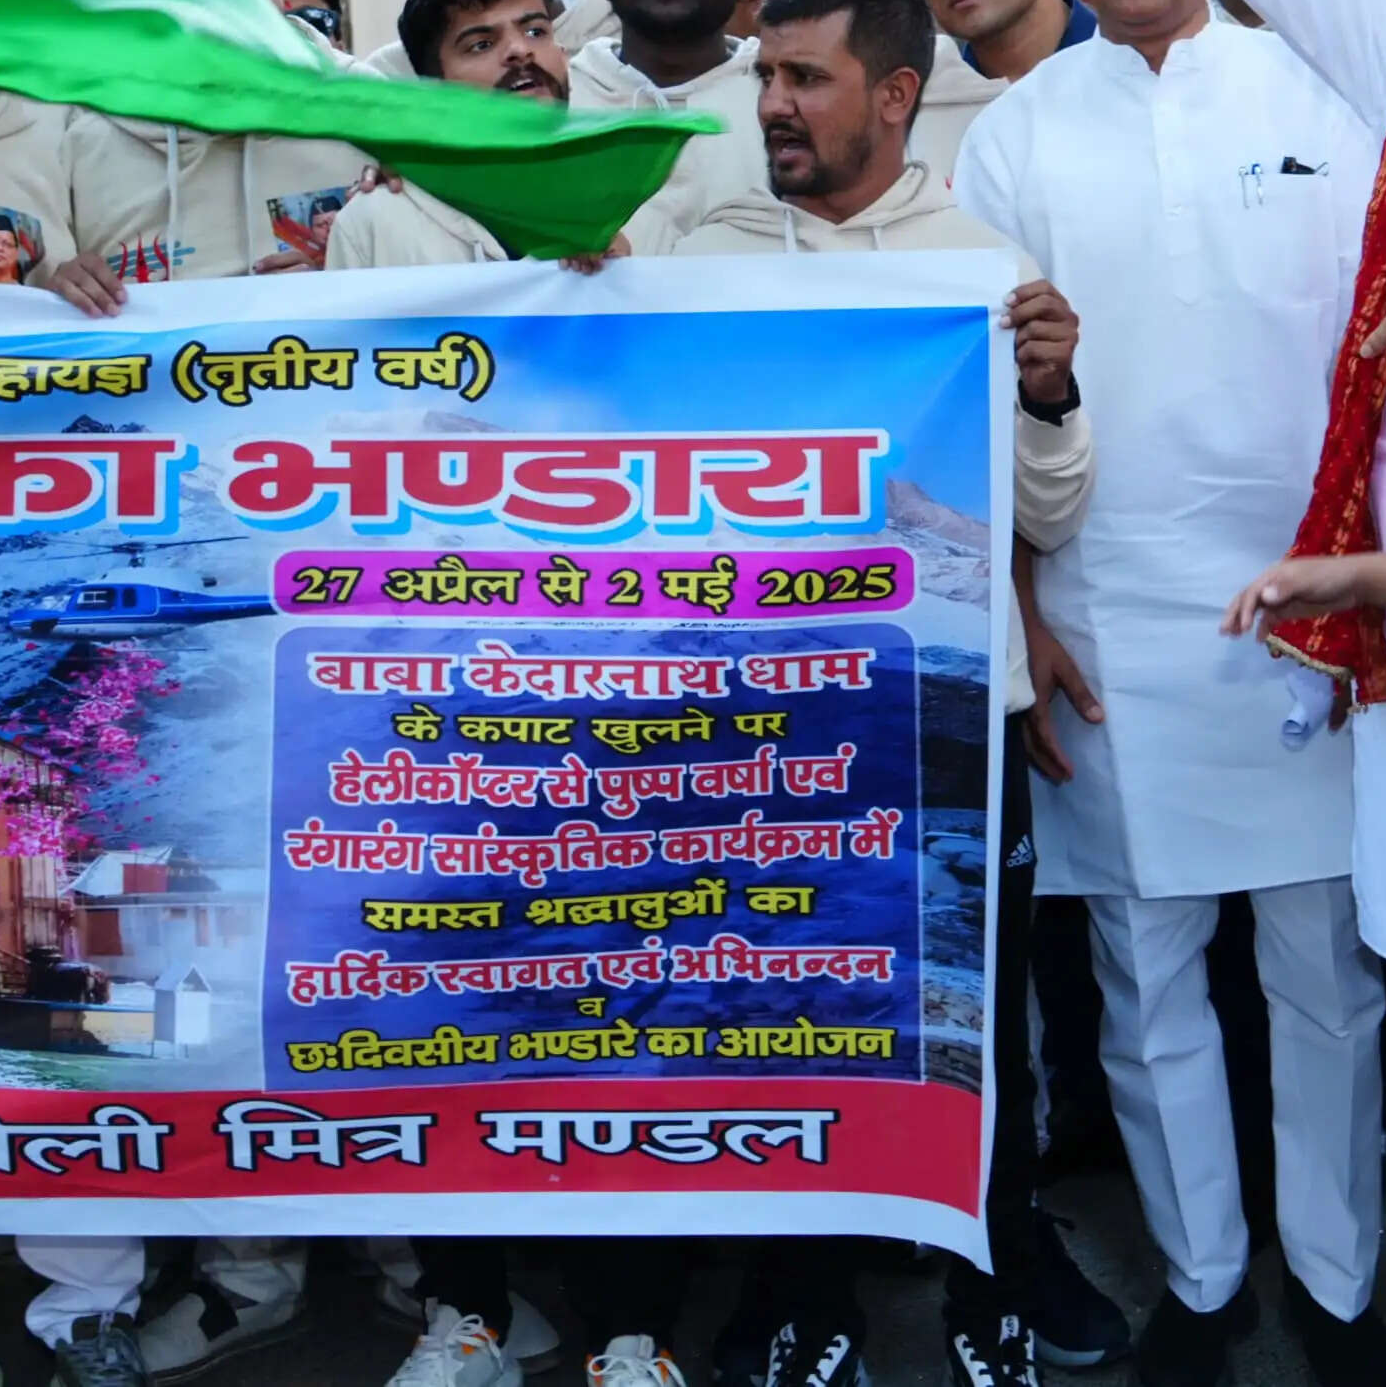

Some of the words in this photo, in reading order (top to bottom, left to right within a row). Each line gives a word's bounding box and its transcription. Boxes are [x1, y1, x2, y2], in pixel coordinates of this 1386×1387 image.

[172, 336, 356, 405] (तृतीय
[374, 331, 495, 401] वर्ष)
[222, 434, 883, 529] भण्डारा
[293, 567, 360, 603] 27
[384, 556, 520, 606] अप्रैल
[538, 557, 587, 605] से
[608, 568, 643, 605] 2
[662, 558, 735, 613] मई
[757, 566, 895, 606] 2025
[313, 654, 453, 694] बाबा
[466, 642, 726, 698] केदारनाथ
[742, 650, 870, 691] धाम
[394, 705, 442, 742] के
[458, 714, 573, 745] कपाट
[592, 708, 715, 753] खुलने
[734, 712, 788, 739] पर
[330, 749, 539, 806] हेलीकॉप्टर
[545, 757, 591, 807] से
[598, 764, 682, 816] पुष्प
[692, 745, 777, 797] वर्षा
[782, 745, 855, 793] एवं
[287, 818, 427, 874] रंगारंग
[433, 821, 652, 887] सांस्कृतिक
[662, 811, 845, 868] कार्यक्रम
[851, 808, 901, 858] में
[363, 898, 503, 931] समस्त
[526, 877, 725, 929] श्रद्धालुओं
[748, 884, 814, 916] का
[289, 953, 427, 1003] हार्दिक
[434, 954, 587, 995] स्वागत
[595, 937, 665, 985] एवं
[671, 933, 894, 984] अभिनन्दन
[508, 1018, 638, 1061] भण्डारे
[647, 1025, 705, 1056] का
[716, 1016, 896, 1059] आयोजन
[577, 996, 606, 1018] व
[218, 1099, 434, 1172] मित्र
[477, 1106, 838, 1165] मण्डल
